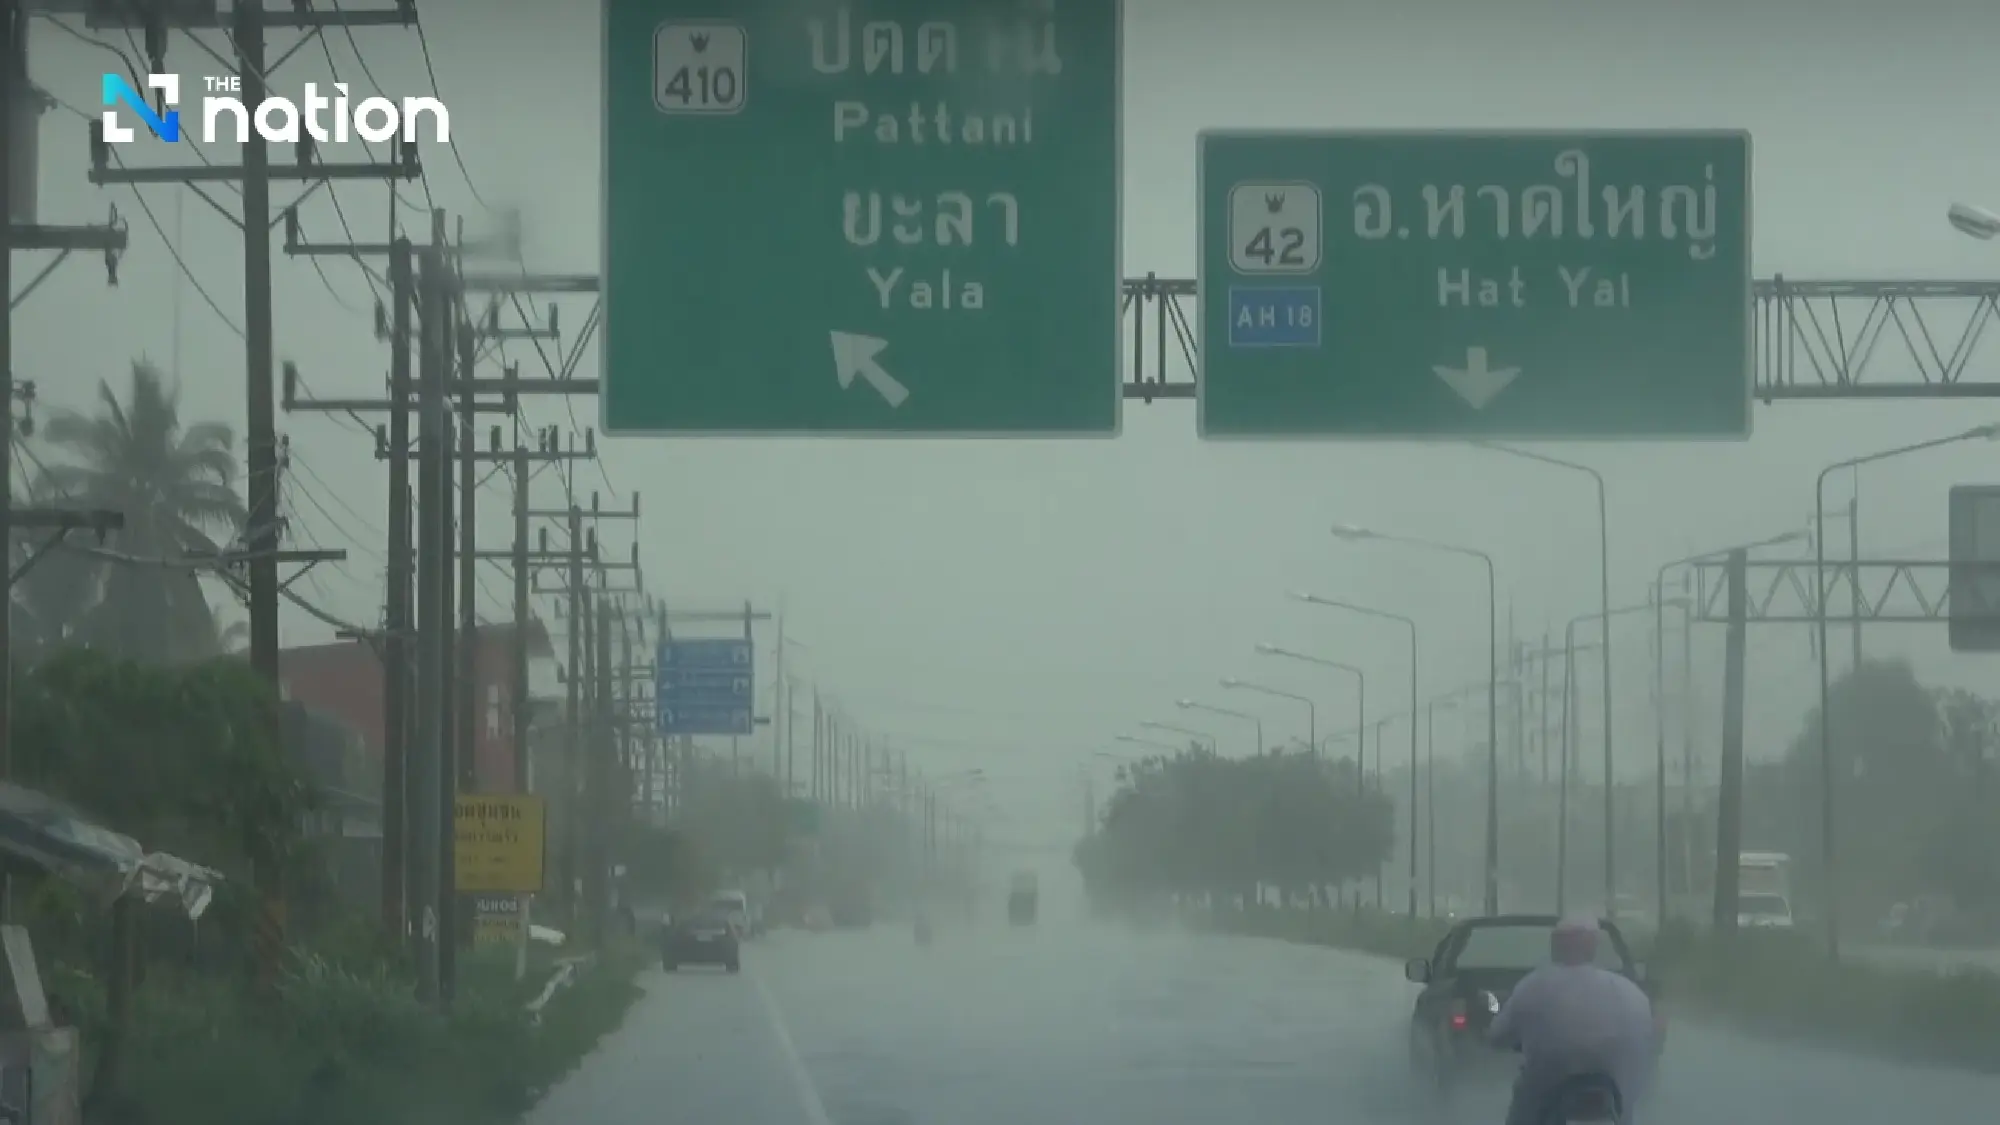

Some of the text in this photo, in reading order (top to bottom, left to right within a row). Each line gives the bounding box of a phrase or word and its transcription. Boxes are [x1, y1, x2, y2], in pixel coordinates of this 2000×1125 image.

[664, 66, 736, 105] 410
[833, 101, 1034, 145] Pattani
[1352, 148, 1718, 261] อ.หาดใหญ่
[1244, 226, 1306, 266] 42
[866, 266, 985, 310] Yala
[1436, 265, 1631, 310] Hat Yai
[1236, 304, 1313, 329] AH 18
